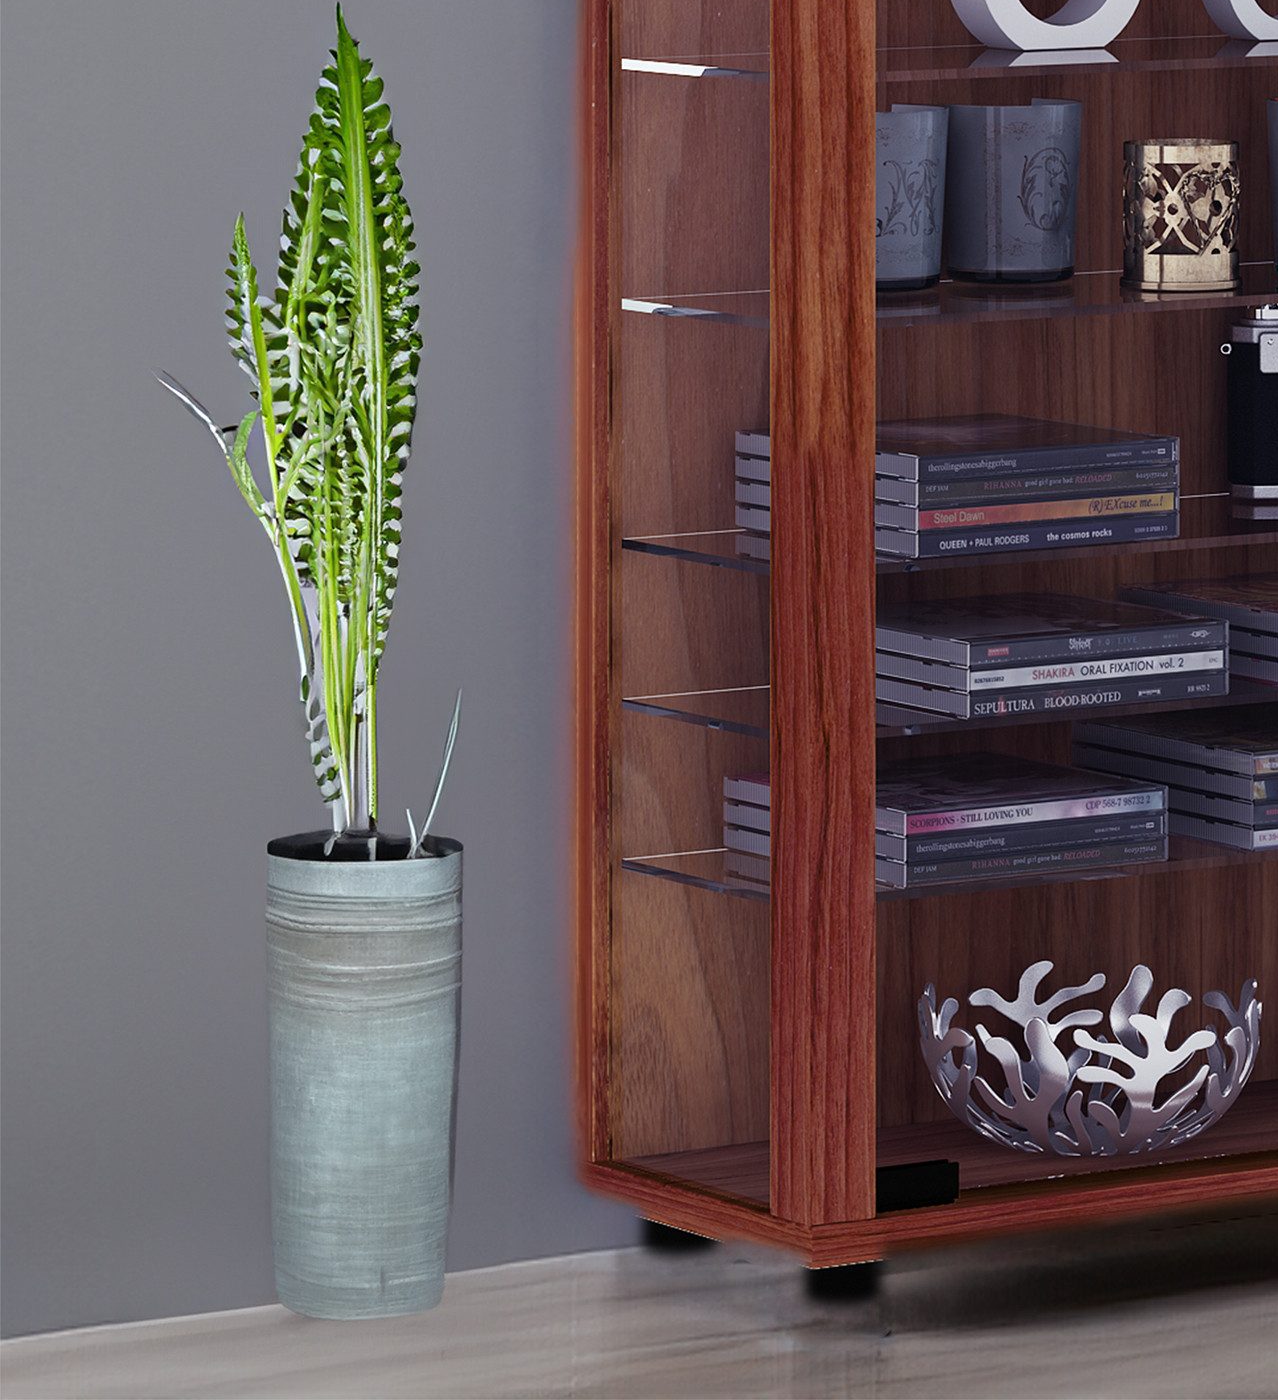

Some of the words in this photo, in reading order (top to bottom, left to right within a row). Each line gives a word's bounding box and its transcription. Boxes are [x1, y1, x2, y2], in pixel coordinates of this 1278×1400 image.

[984, 481, 1022, 490] RIHANNA
[1075, 473, 1113, 484] RELOADED
[933, 512, 957, 524] Steel
[960, 511, 985, 522] Dawn
[939, 540, 967, 550] QUEEN
[975, 537, 993, 548] PAUL
[994, 534, 1030, 546] RODGERS
[1046, 532, 1060, 541] the
[1061, 530, 1090, 540] cosmos
[1091, 528, 1113, 538] rocks
[1032, 667, 1075, 681] SHAKIRA
[1080, 664, 1107, 676] ORAL
[1109, 660, 1154, 673] FIXATION
[1158, 658, 1176, 669] vol.
[1178, 658, 1185, 668] 2
[974, 699, 1035, 716] SEPULTURA
[1044, 691, 1122, 709] BLOOD-ROOTED
[910, 815, 956, 829] SCORPIONS
[960, 812, 984, 823] STILL
[984, 809, 1014, 821] LOVING
[1015, 807, 1034, 817] YOU
[1085, 800, 1102, 810] CDP
[1146, 795, 1151, 804] 2
[971, 858, 1010, 869] RIHANNA
[1063, 849, 1100, 860] RELOADED
